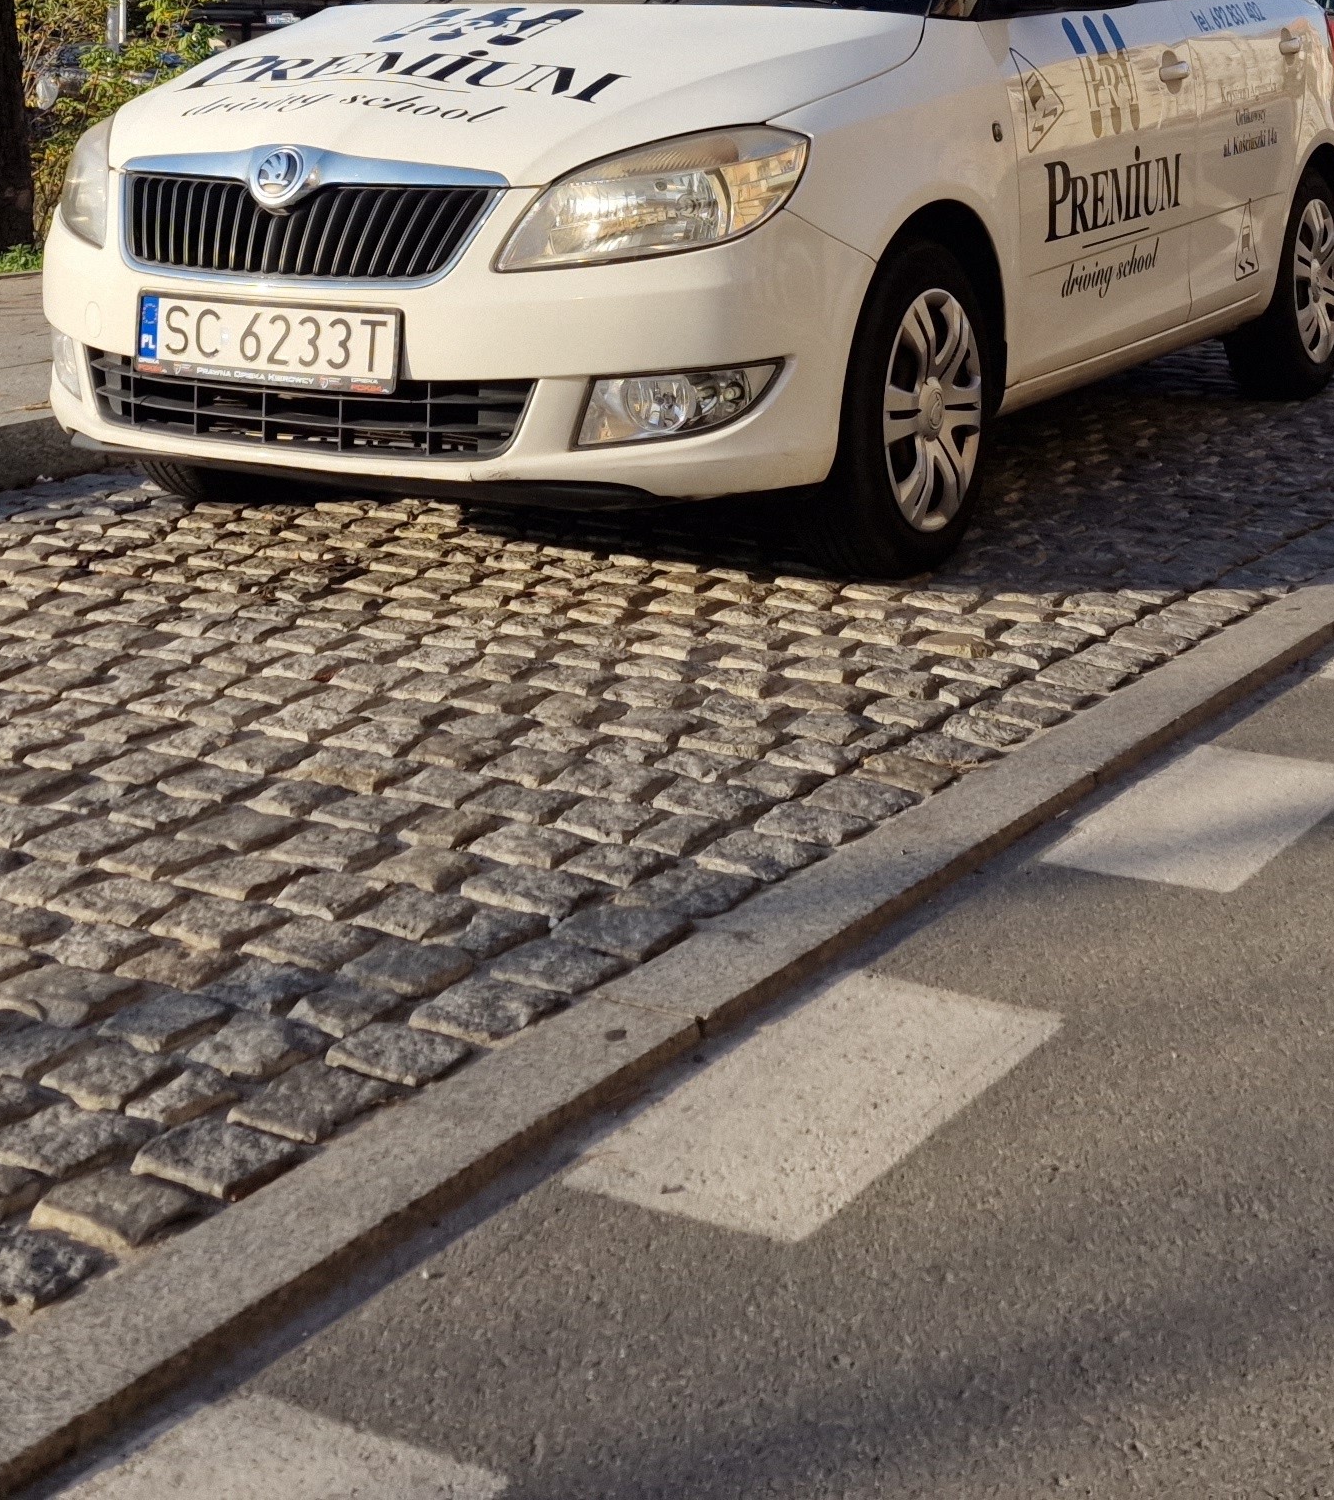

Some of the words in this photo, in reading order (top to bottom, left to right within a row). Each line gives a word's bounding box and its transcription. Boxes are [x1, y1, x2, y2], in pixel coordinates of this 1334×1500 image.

[1189, 8, 1215, 33] tel.
[1209, 5, 1233, 30] 692
[1225, 3, 1249, 26] 831
[181, 93, 335, 117] driving
[339, 91, 508, 124] school
[1061, 260, 1113, 299] driving
[1116, 236, 1160, 280] school
[141, 334, 156, 349] PL
[165, 305, 221, 358] SC
[239, 312, 388, 373] 6233T
[196, 367, 232, 377] PRAWNA
